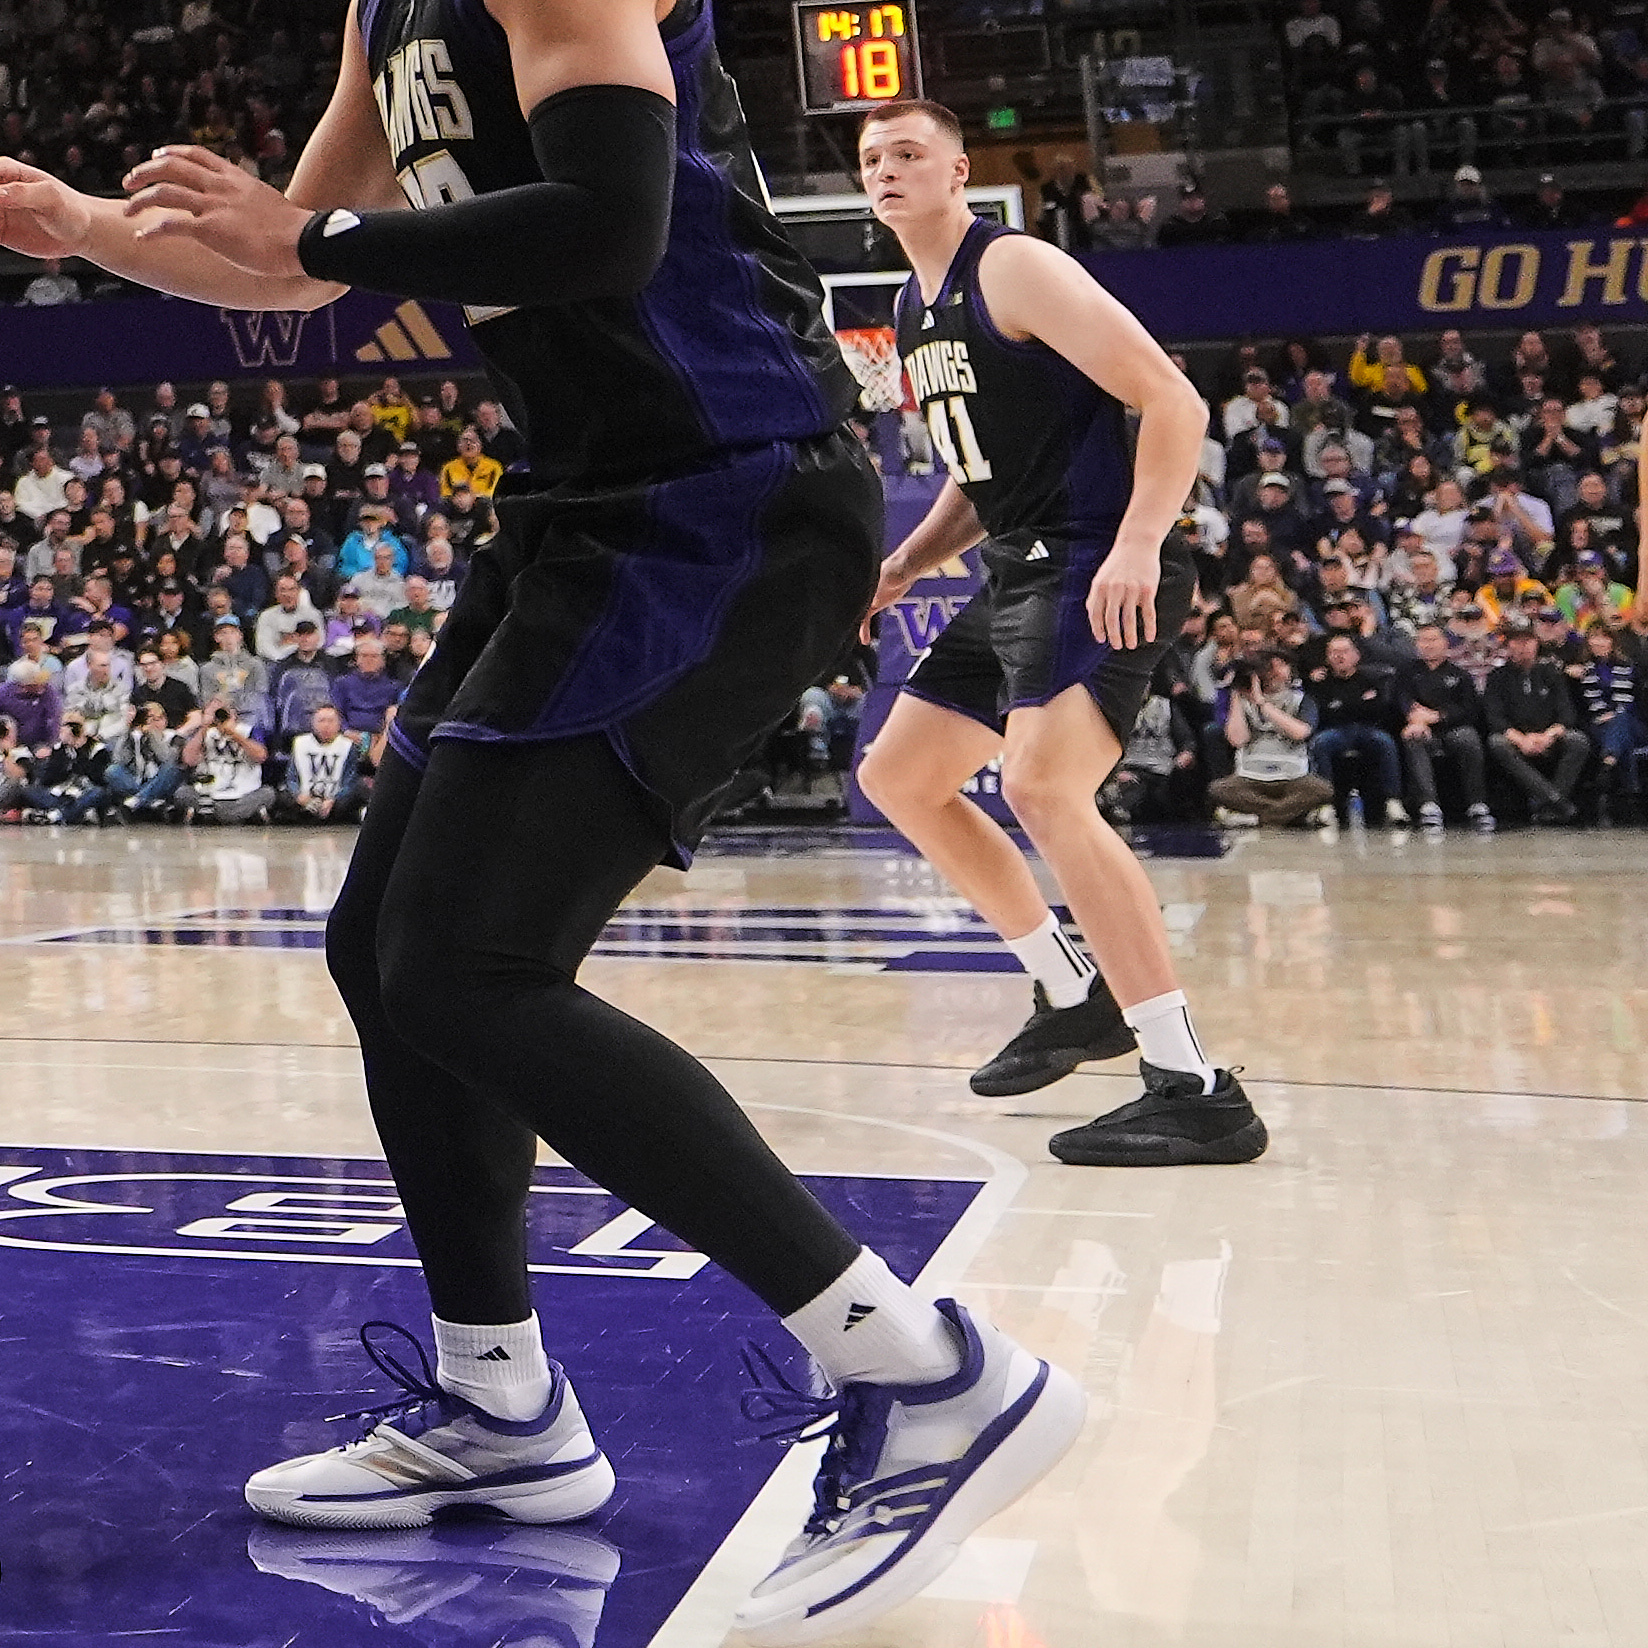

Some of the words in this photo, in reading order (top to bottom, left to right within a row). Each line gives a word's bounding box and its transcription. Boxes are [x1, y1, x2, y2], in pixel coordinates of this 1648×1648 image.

[817, 4, 905, 42] 14:17
[842, 38, 902, 100] 18
[1419, 244, 1544, 314] GO
